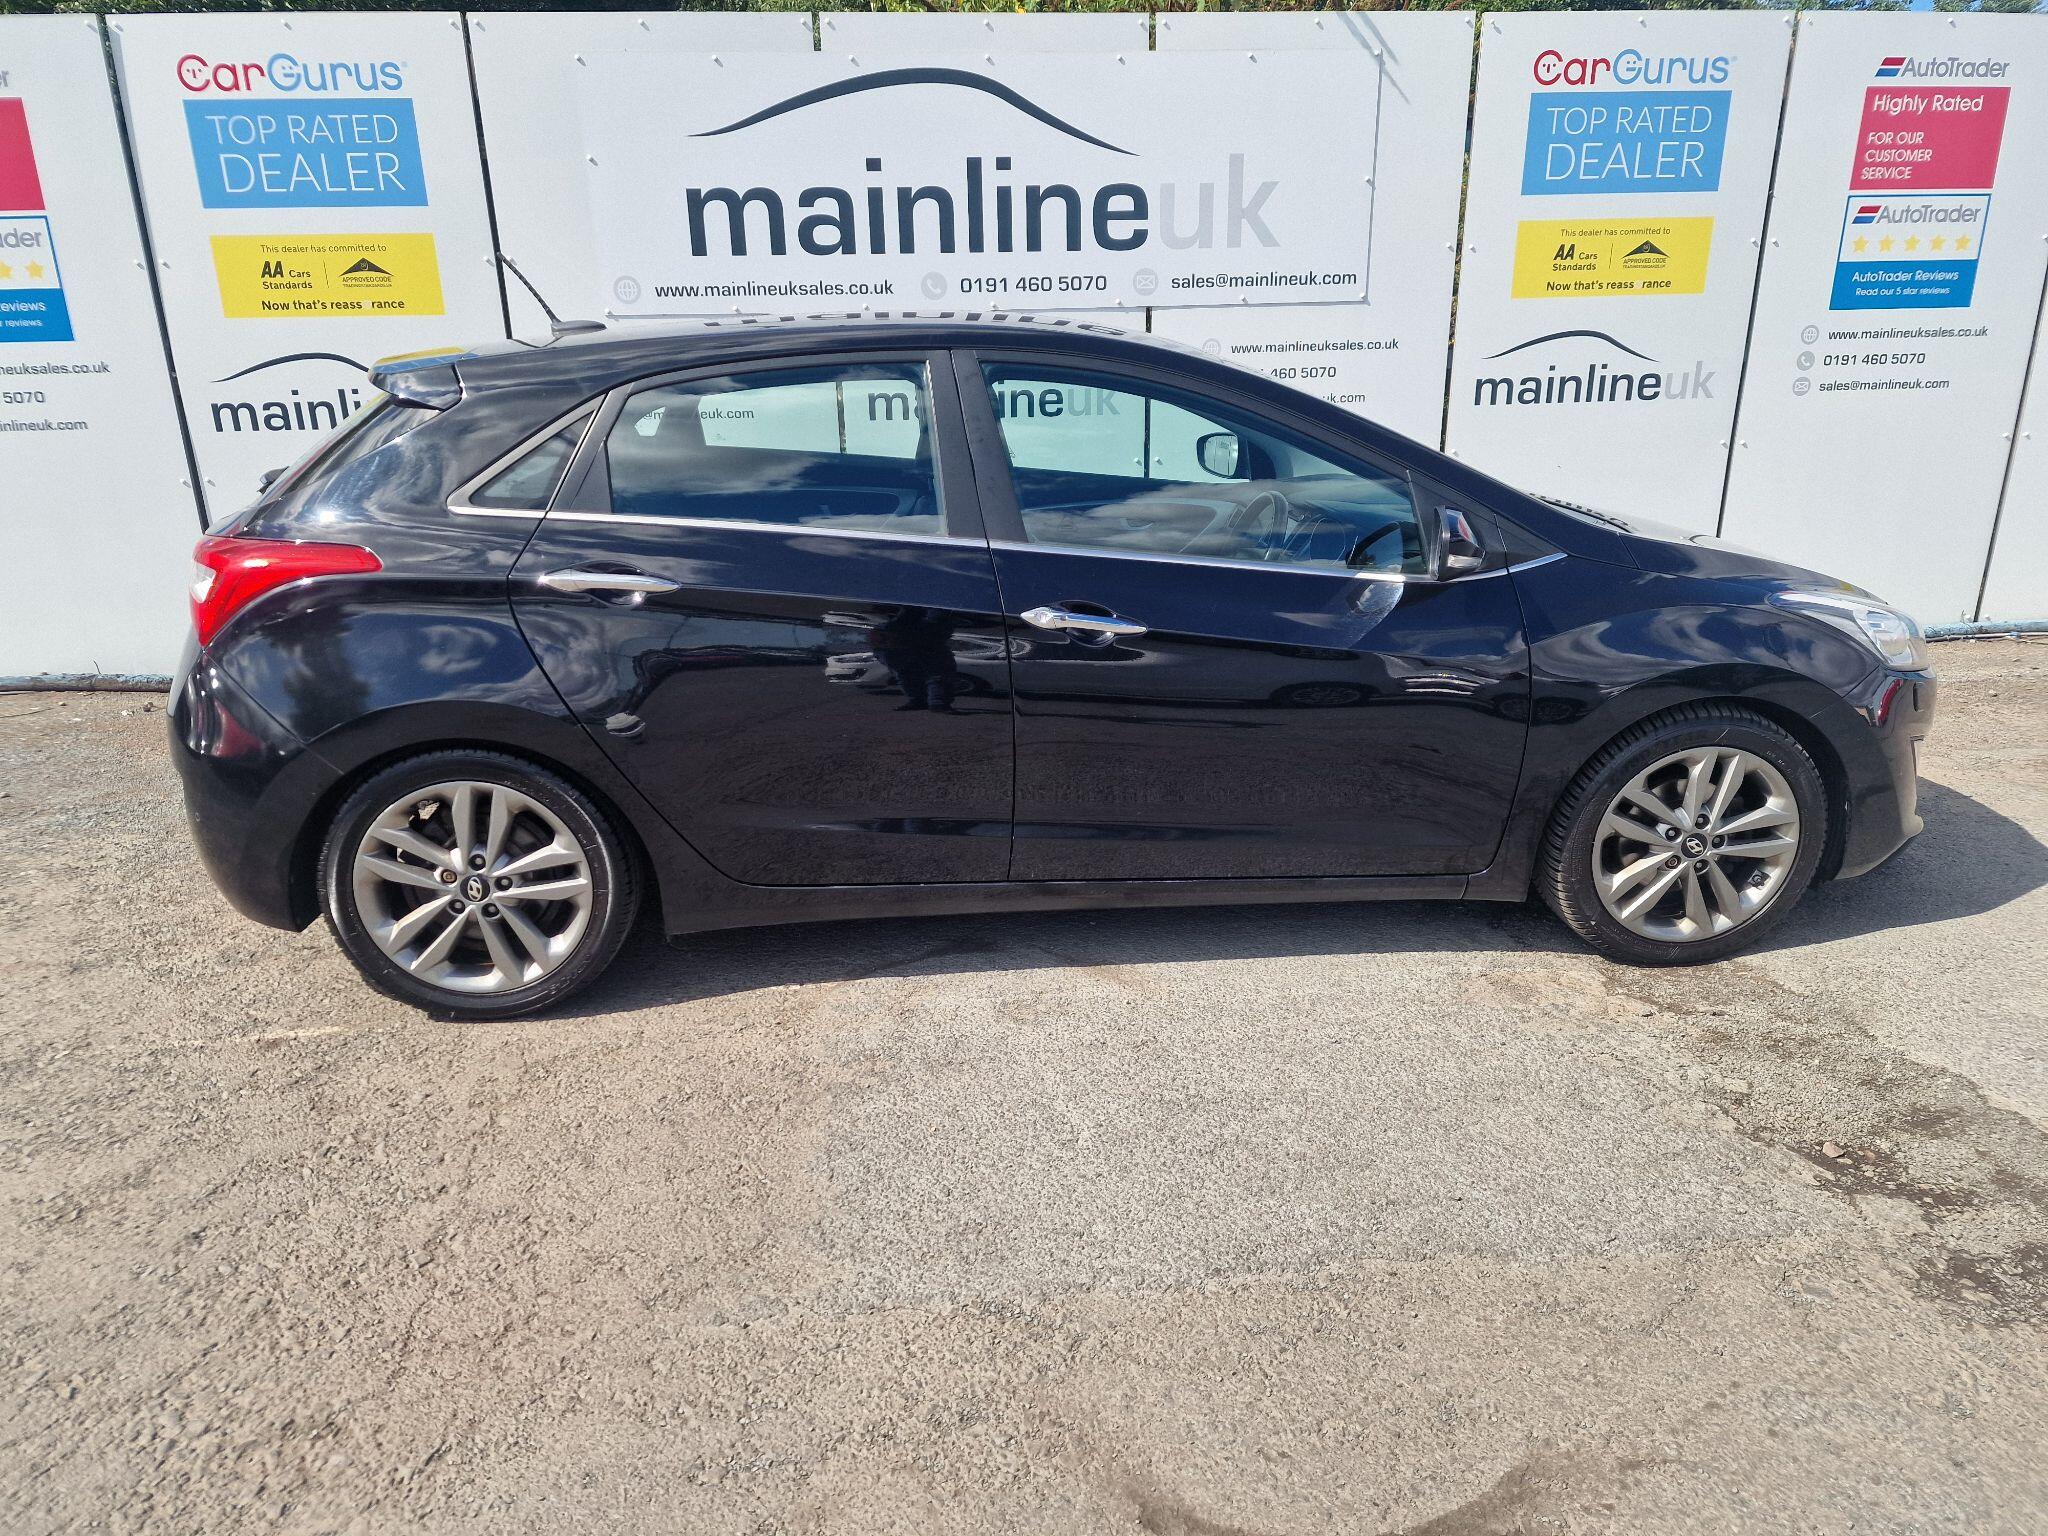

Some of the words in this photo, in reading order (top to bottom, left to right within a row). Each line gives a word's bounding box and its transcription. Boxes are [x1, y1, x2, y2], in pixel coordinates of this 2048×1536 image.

[177, 53, 403, 92] CarGurus
[1533, 48, 1730, 86] CarGurus
[1901, 56, 2010, 78] AutoTrader
[1873, 94, 1928, 116] Highly
[1932, 94, 1984, 112] Rated
[1546, 107, 1607, 135] TOP
[1616, 105, 1713, 134] RATED
[204, 114, 277, 145] TOP
[287, 114, 398, 144] RATED
[1868, 131, 1893, 145] FOR
[1896, 131, 1924, 145] OUR
[1545, 141, 1705, 181] DEALER
[1865, 149, 1933, 163] CUSTOMER
[218, 152, 407, 193] DEALER
[1861, 166, 1913, 180] SERVICE
[685, 153, 1281, 257] mainlineuk
[1876, 204, 1981, 225] AutoTrader
[1560, 228, 1577, 237] This
[1578, 228, 1603, 237] dealer
[1604, 228, 1618, 236] has
[1619, 226, 1661, 236] committed
[1662, 227, 1671, 235] to
[260, 244, 280, 253] This
[281, 244, 309, 253] dealer
[310, 244, 326, 253] has
[328, 243, 376, 253] committed
[377, 243, 387, 252] to
[1553, 243, 1576, 261] AA
[1579, 251, 1598, 261] Cars
[260, 260, 284, 279] AA
[288, 269, 311, 279] Cars
[1552, 262, 1597, 272] Standards
[1171, 270, 1357, 291] sales@mainlineuk.com
[1852, 270, 1913, 283] AutoTrader
[1915, 269, 1960, 281] Reviews
[262, 280, 313, 290] Standards
[654, 279, 894, 298] www.mainlineuksales.co.uk
[960, 277, 1009, 294] 0191
[1015, 276, 1052, 293] 460
[1058, 275, 1107, 292] 5070
[1546, 280, 1571, 291] Now
[1574, 280, 1604, 291] that's
[1606, 279, 1672, 290] reassrance
[1855, 287, 1879, 296] Read
[1880, 288, 1894, 296] our
[1896, 286, 1902, 295] 5
[1919, 286, 1950, 295] reviews
[0, 300, 46, 312] eviews
[261, 300, 290, 311] Now
[293, 299, 328, 310] that's
[330, 299, 405, 310] reassrance
[5, 318, 43, 328] reviews
[1828, 325, 1989, 340] www.mainlineuksales.co.uk
[1230, 337, 1400, 354] www.mainlineuksales.co.uk
[1823, 354, 1857, 366] 0191
[1861, 353, 1888, 366] 460
[1890, 352, 1926, 365] 5070
[1301, 366, 1337, 379] 5070
[1474, 360, 1716, 406] mainlineuk
[1819, 377, 1950, 392] sales@mainlineuk.com
[2, 391, 46, 404] 5070
